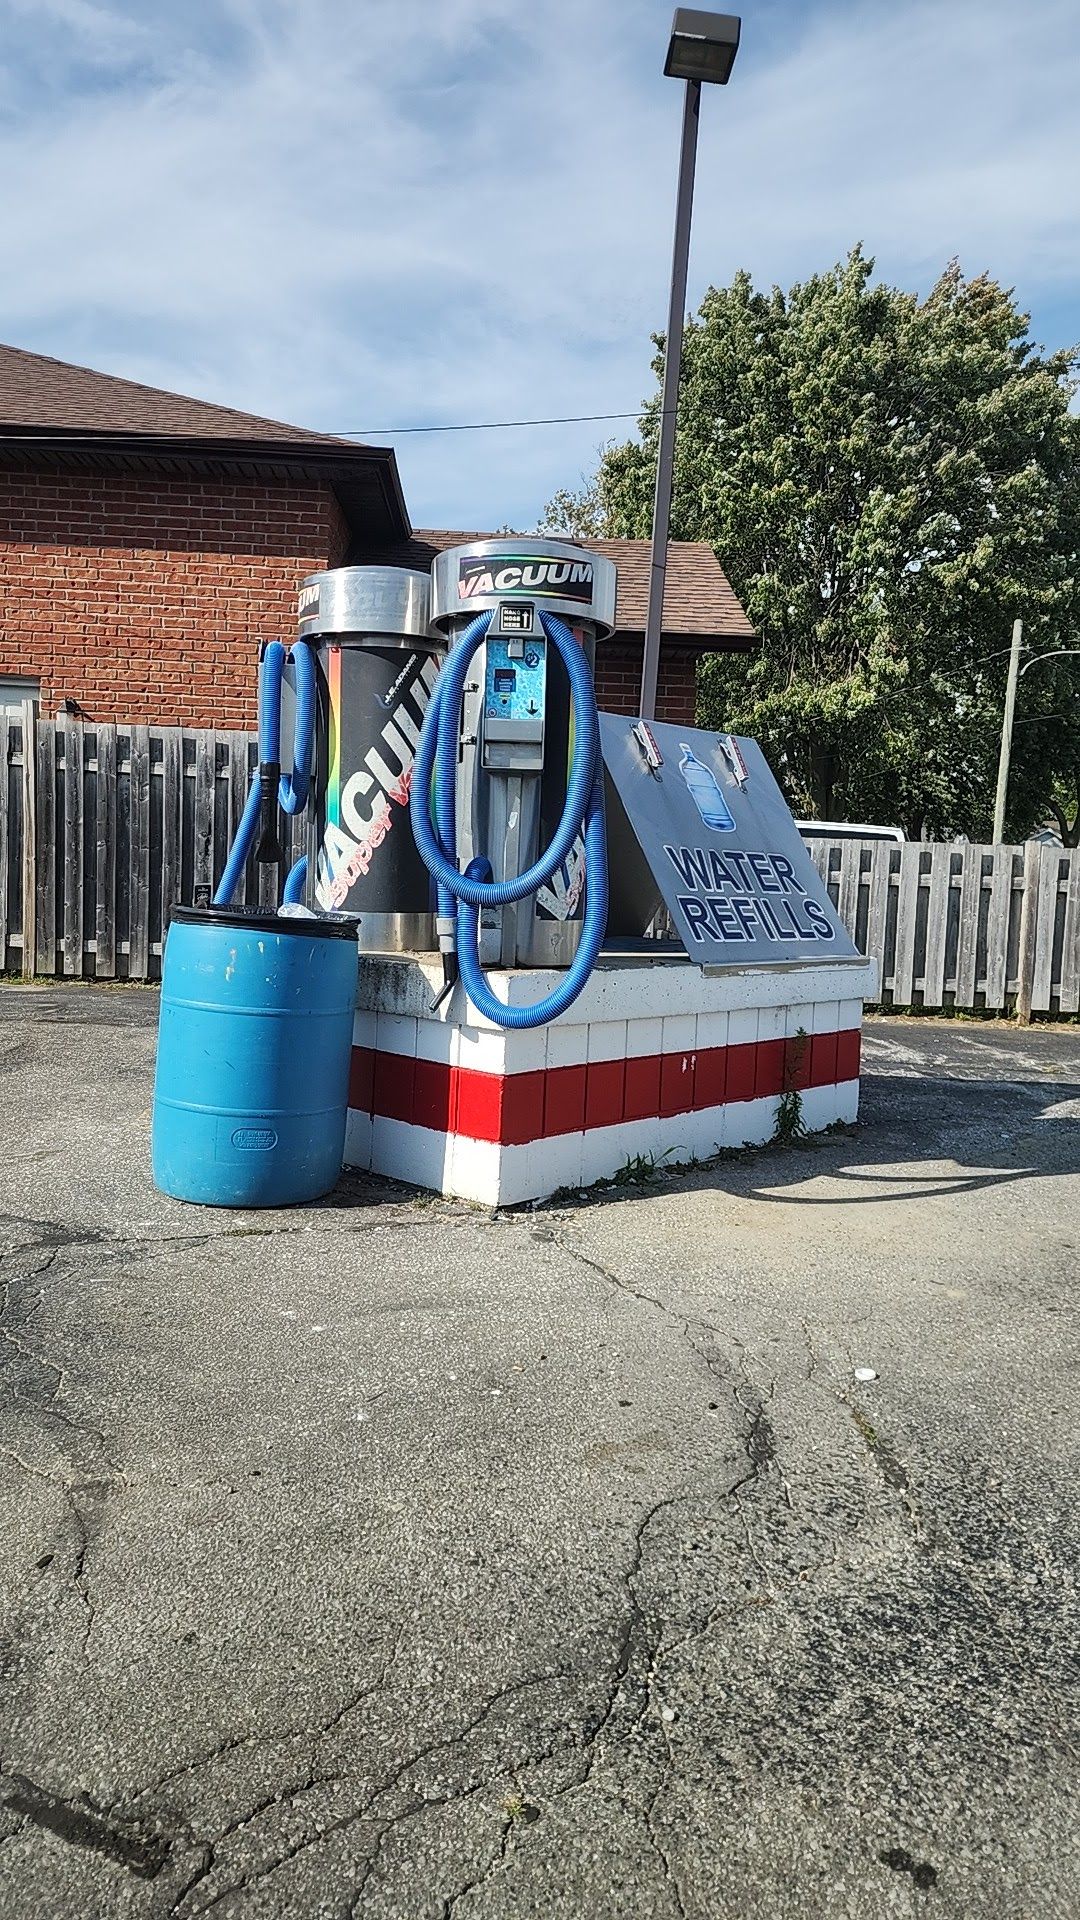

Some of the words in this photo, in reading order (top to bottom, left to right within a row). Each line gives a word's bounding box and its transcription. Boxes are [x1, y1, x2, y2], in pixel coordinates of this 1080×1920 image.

[457, 563, 593, 599] VACUUM
[662, 845, 808, 895] WATER
[675, 894, 836, 943] REFILLS
